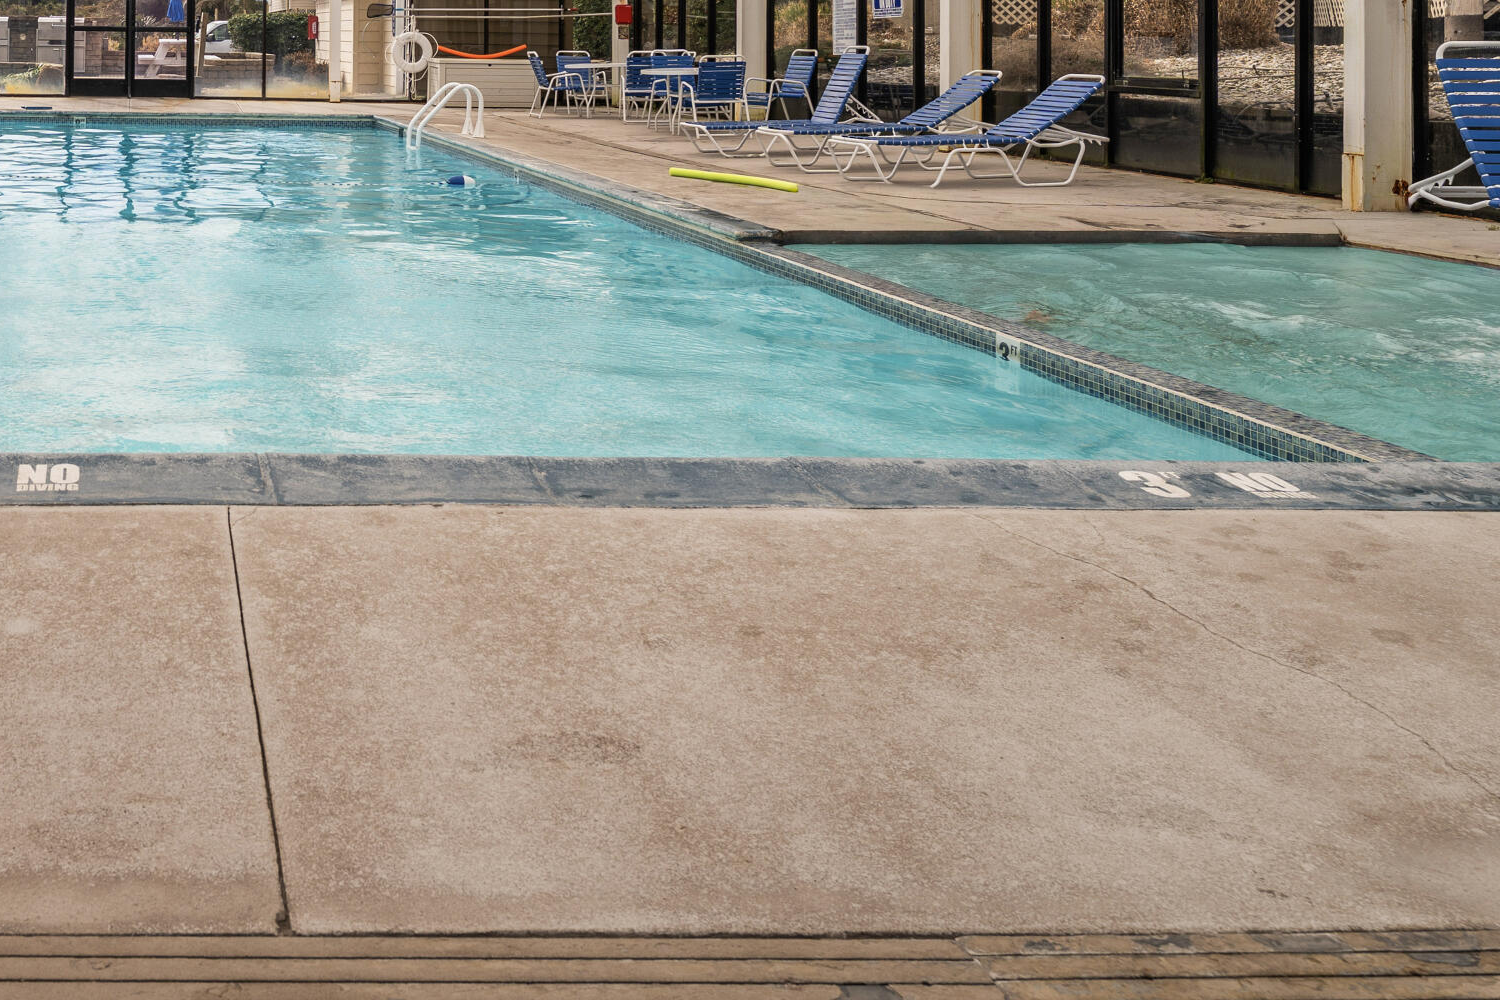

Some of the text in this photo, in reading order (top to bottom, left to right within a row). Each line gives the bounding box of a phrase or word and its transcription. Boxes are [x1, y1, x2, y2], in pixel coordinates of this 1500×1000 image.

[1011, 345, 1017, 356] FT
[16, 463, 80, 484] NO
[1214, 473, 1301, 491] NO
[16, 483, 79, 492] DIVING
[1118, 471, 1192, 498] 3
